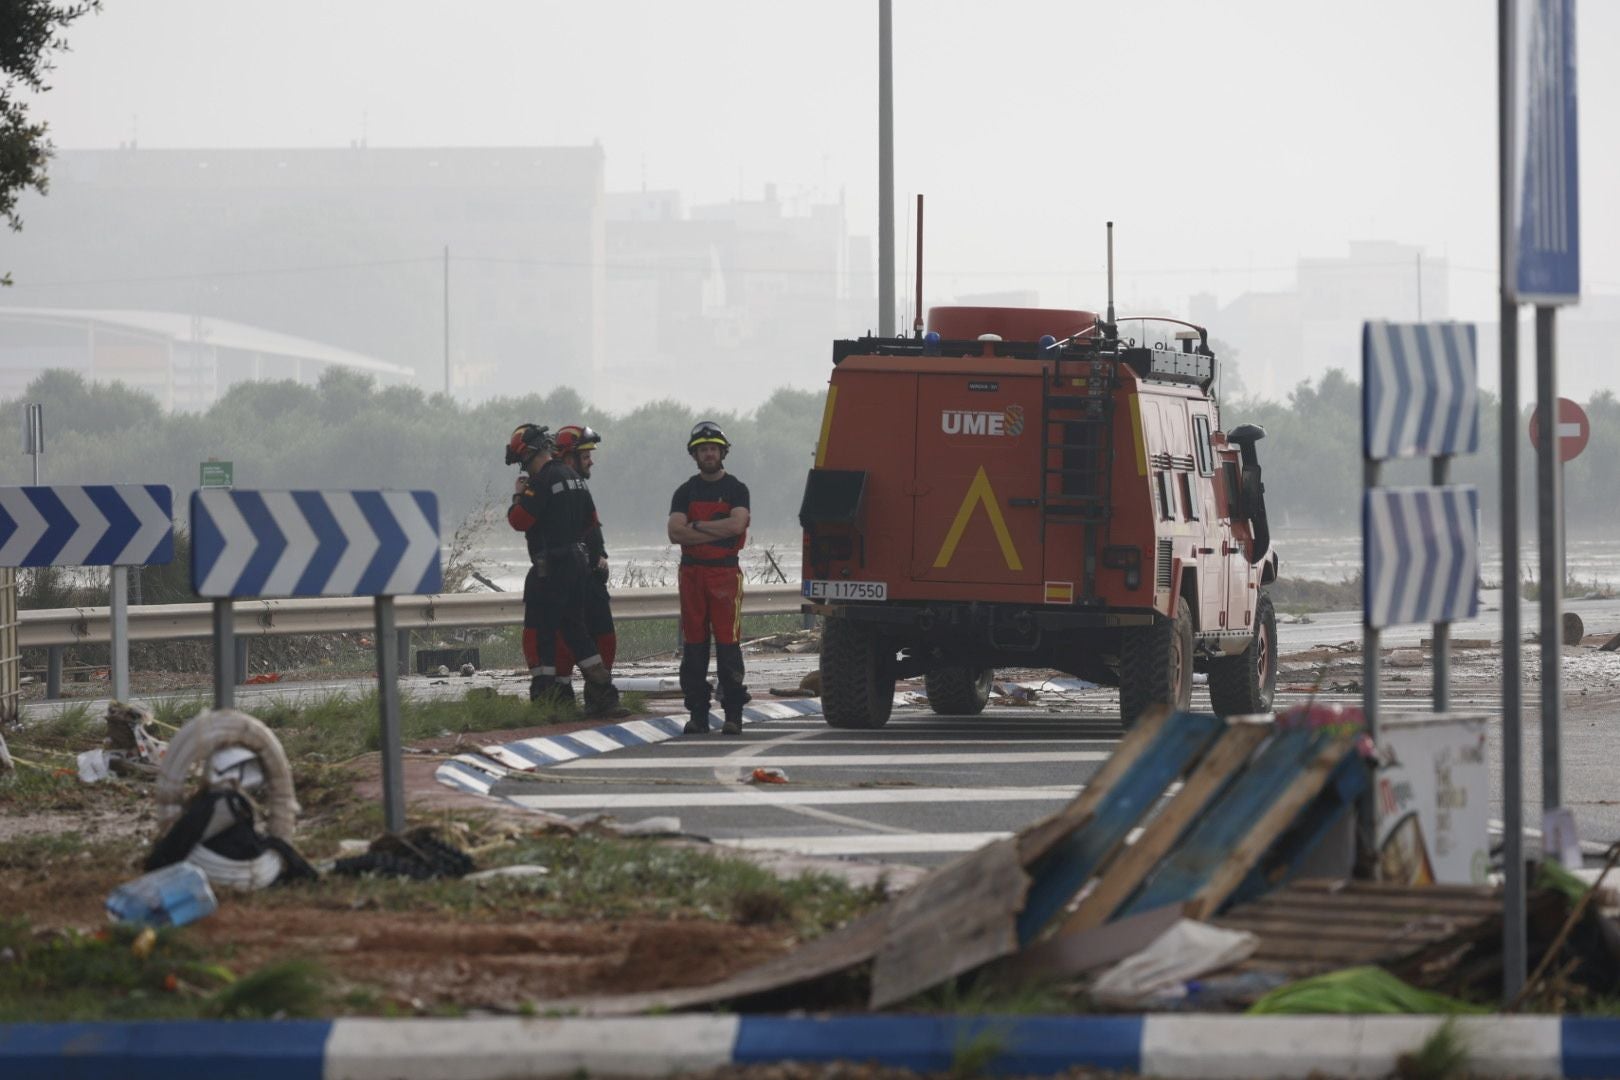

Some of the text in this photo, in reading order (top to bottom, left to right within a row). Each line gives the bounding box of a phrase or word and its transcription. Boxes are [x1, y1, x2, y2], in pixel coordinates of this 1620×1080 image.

[942, 413, 1005, 435] UME
[812, 582, 884, 599] ET 117550
